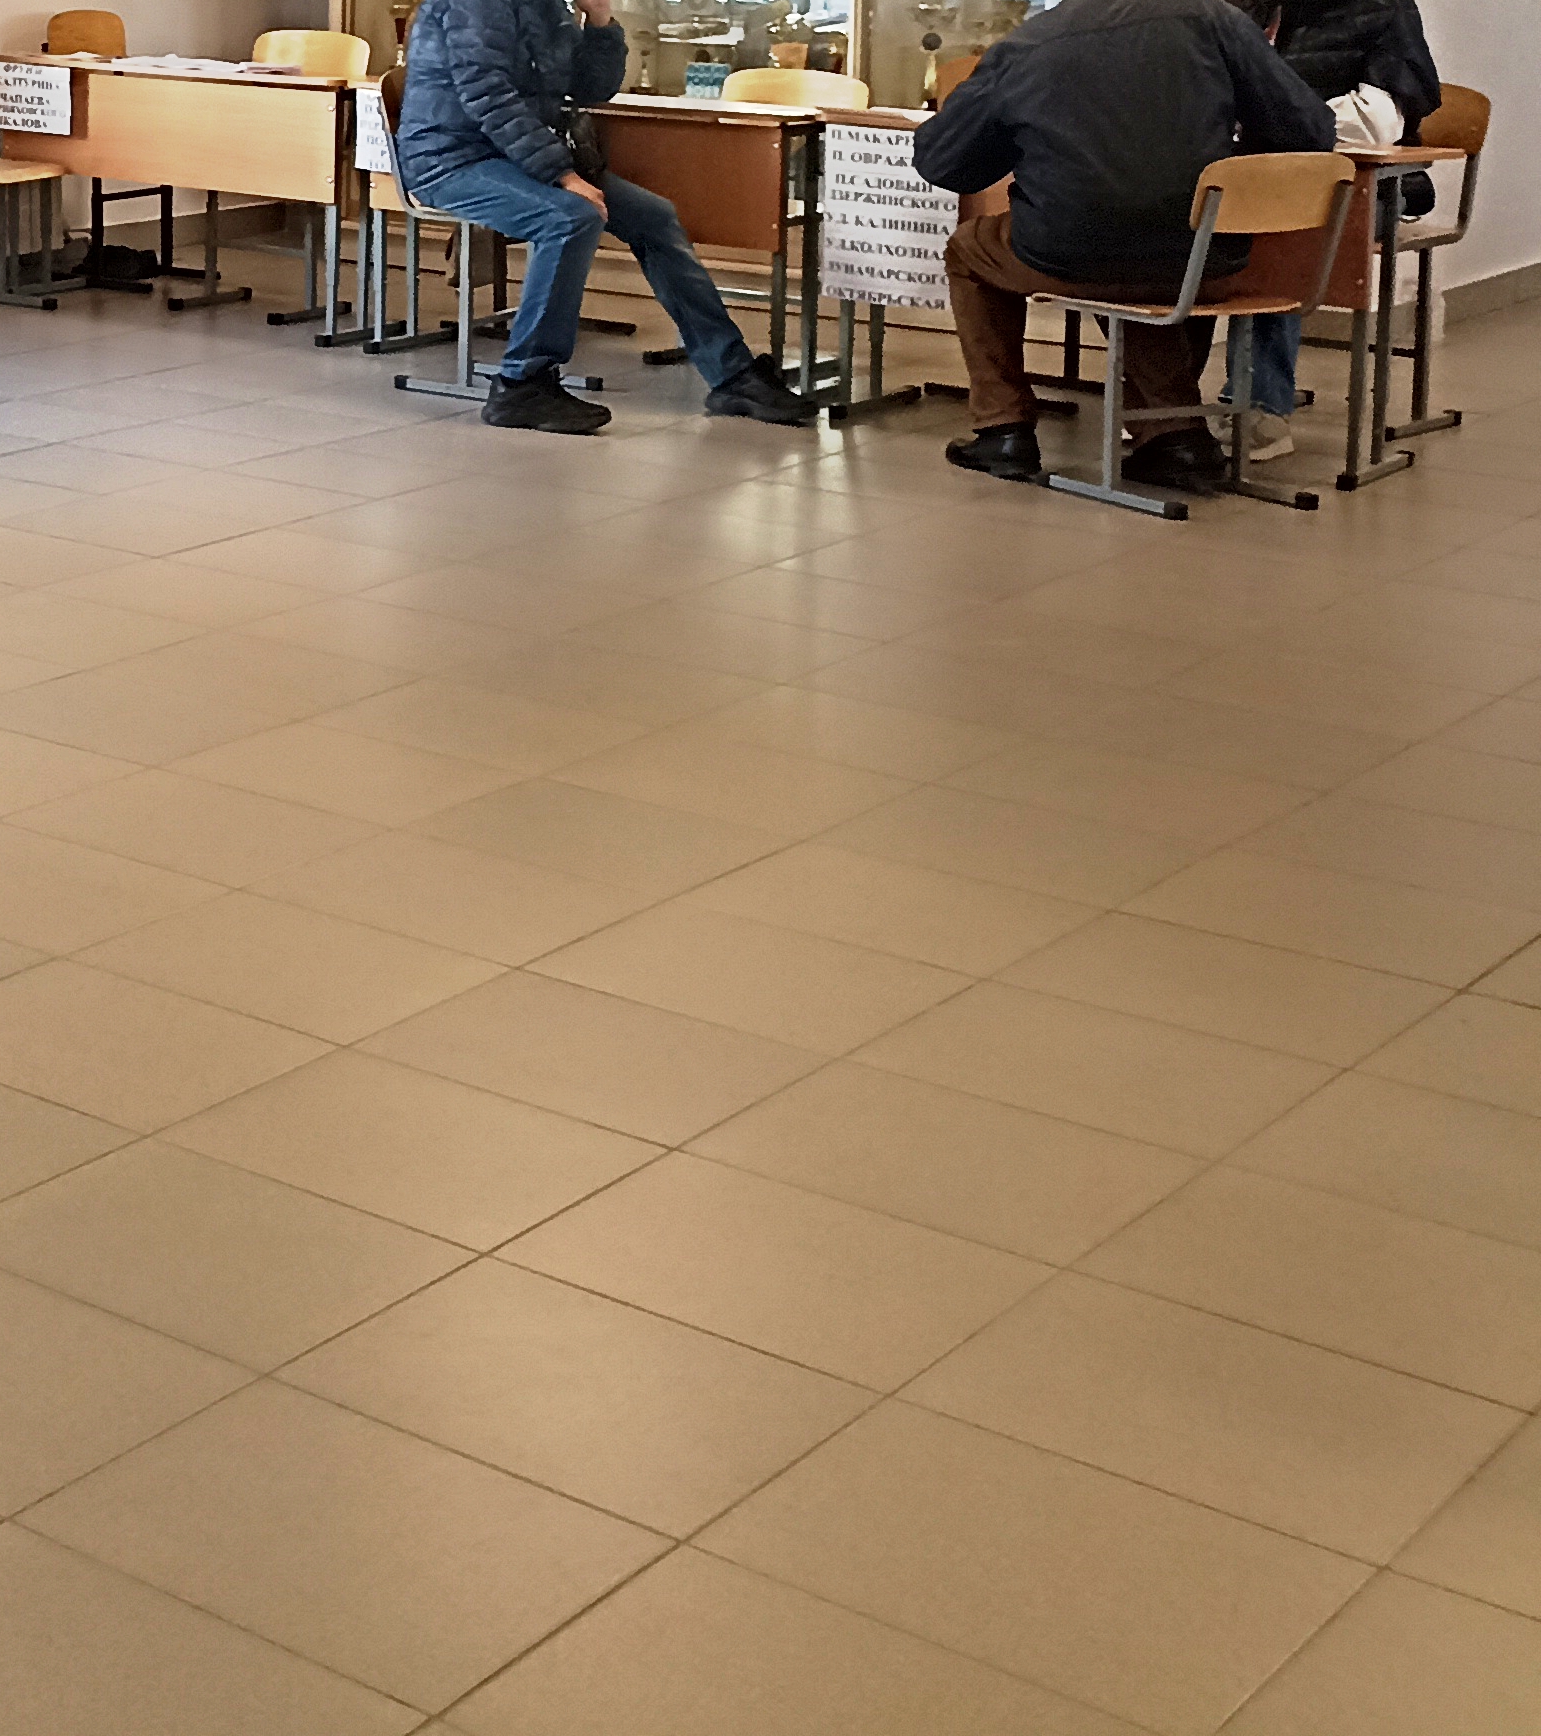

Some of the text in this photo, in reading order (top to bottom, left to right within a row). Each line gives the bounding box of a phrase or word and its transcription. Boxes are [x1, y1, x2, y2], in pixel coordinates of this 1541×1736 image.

[850, 152, 911, 168] ОВРАЖ
[853, 214, 950, 236] КАЛИНИНА
[826, 285, 946, 310] ОКТЯБРЬСКАЯ
